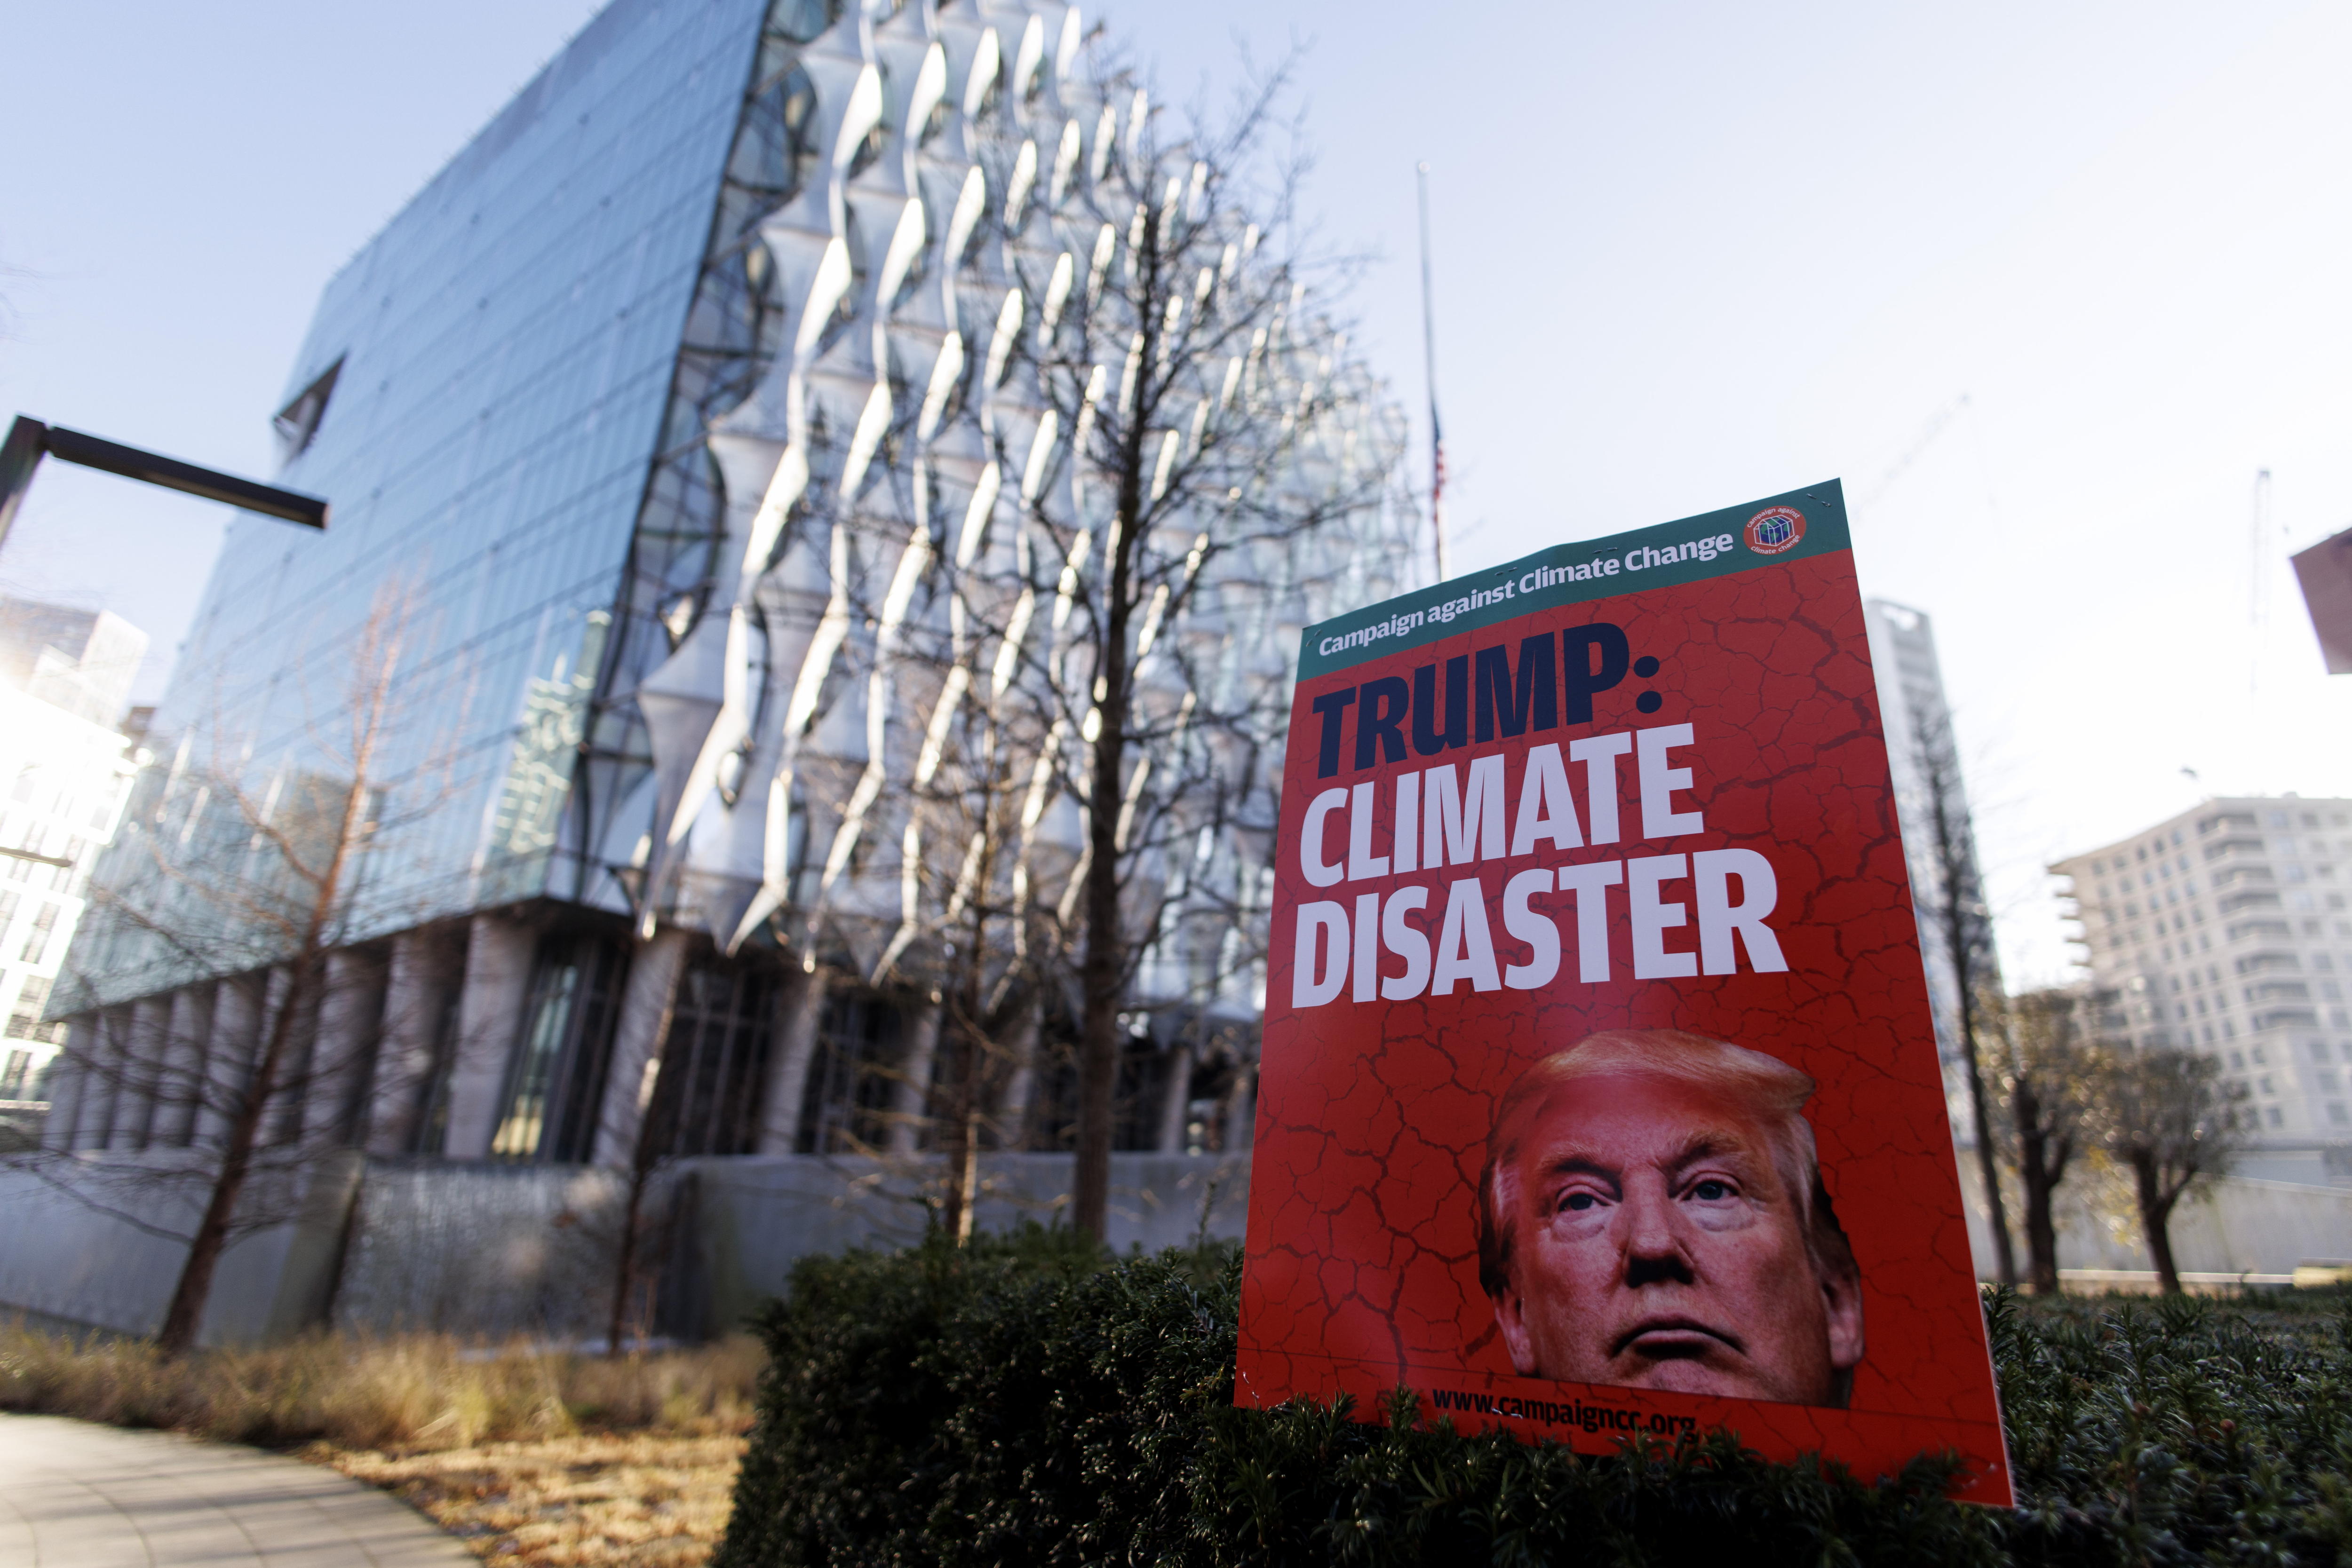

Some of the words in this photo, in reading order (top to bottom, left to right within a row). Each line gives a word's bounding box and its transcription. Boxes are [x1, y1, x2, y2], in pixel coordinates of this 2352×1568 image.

[1747, 508, 1776, 528] campaign
[1778, 507, 1800, 519] against
[1778, 535, 1800, 552] change
[1319, 607, 1424, 657] Campaign
[1427, 580, 1515, 625] against
[1519, 558, 1621, 594] Climate
[1624, 532, 1733, 571] Change
[1311, 622, 1662, 779] TRUMP:
[1300, 723, 1704, 887] CLIMATE
[1292, 848, 1789, 1009] DISASTER
[1432, 1388, 1695, 1444] www.campaigncc.org
